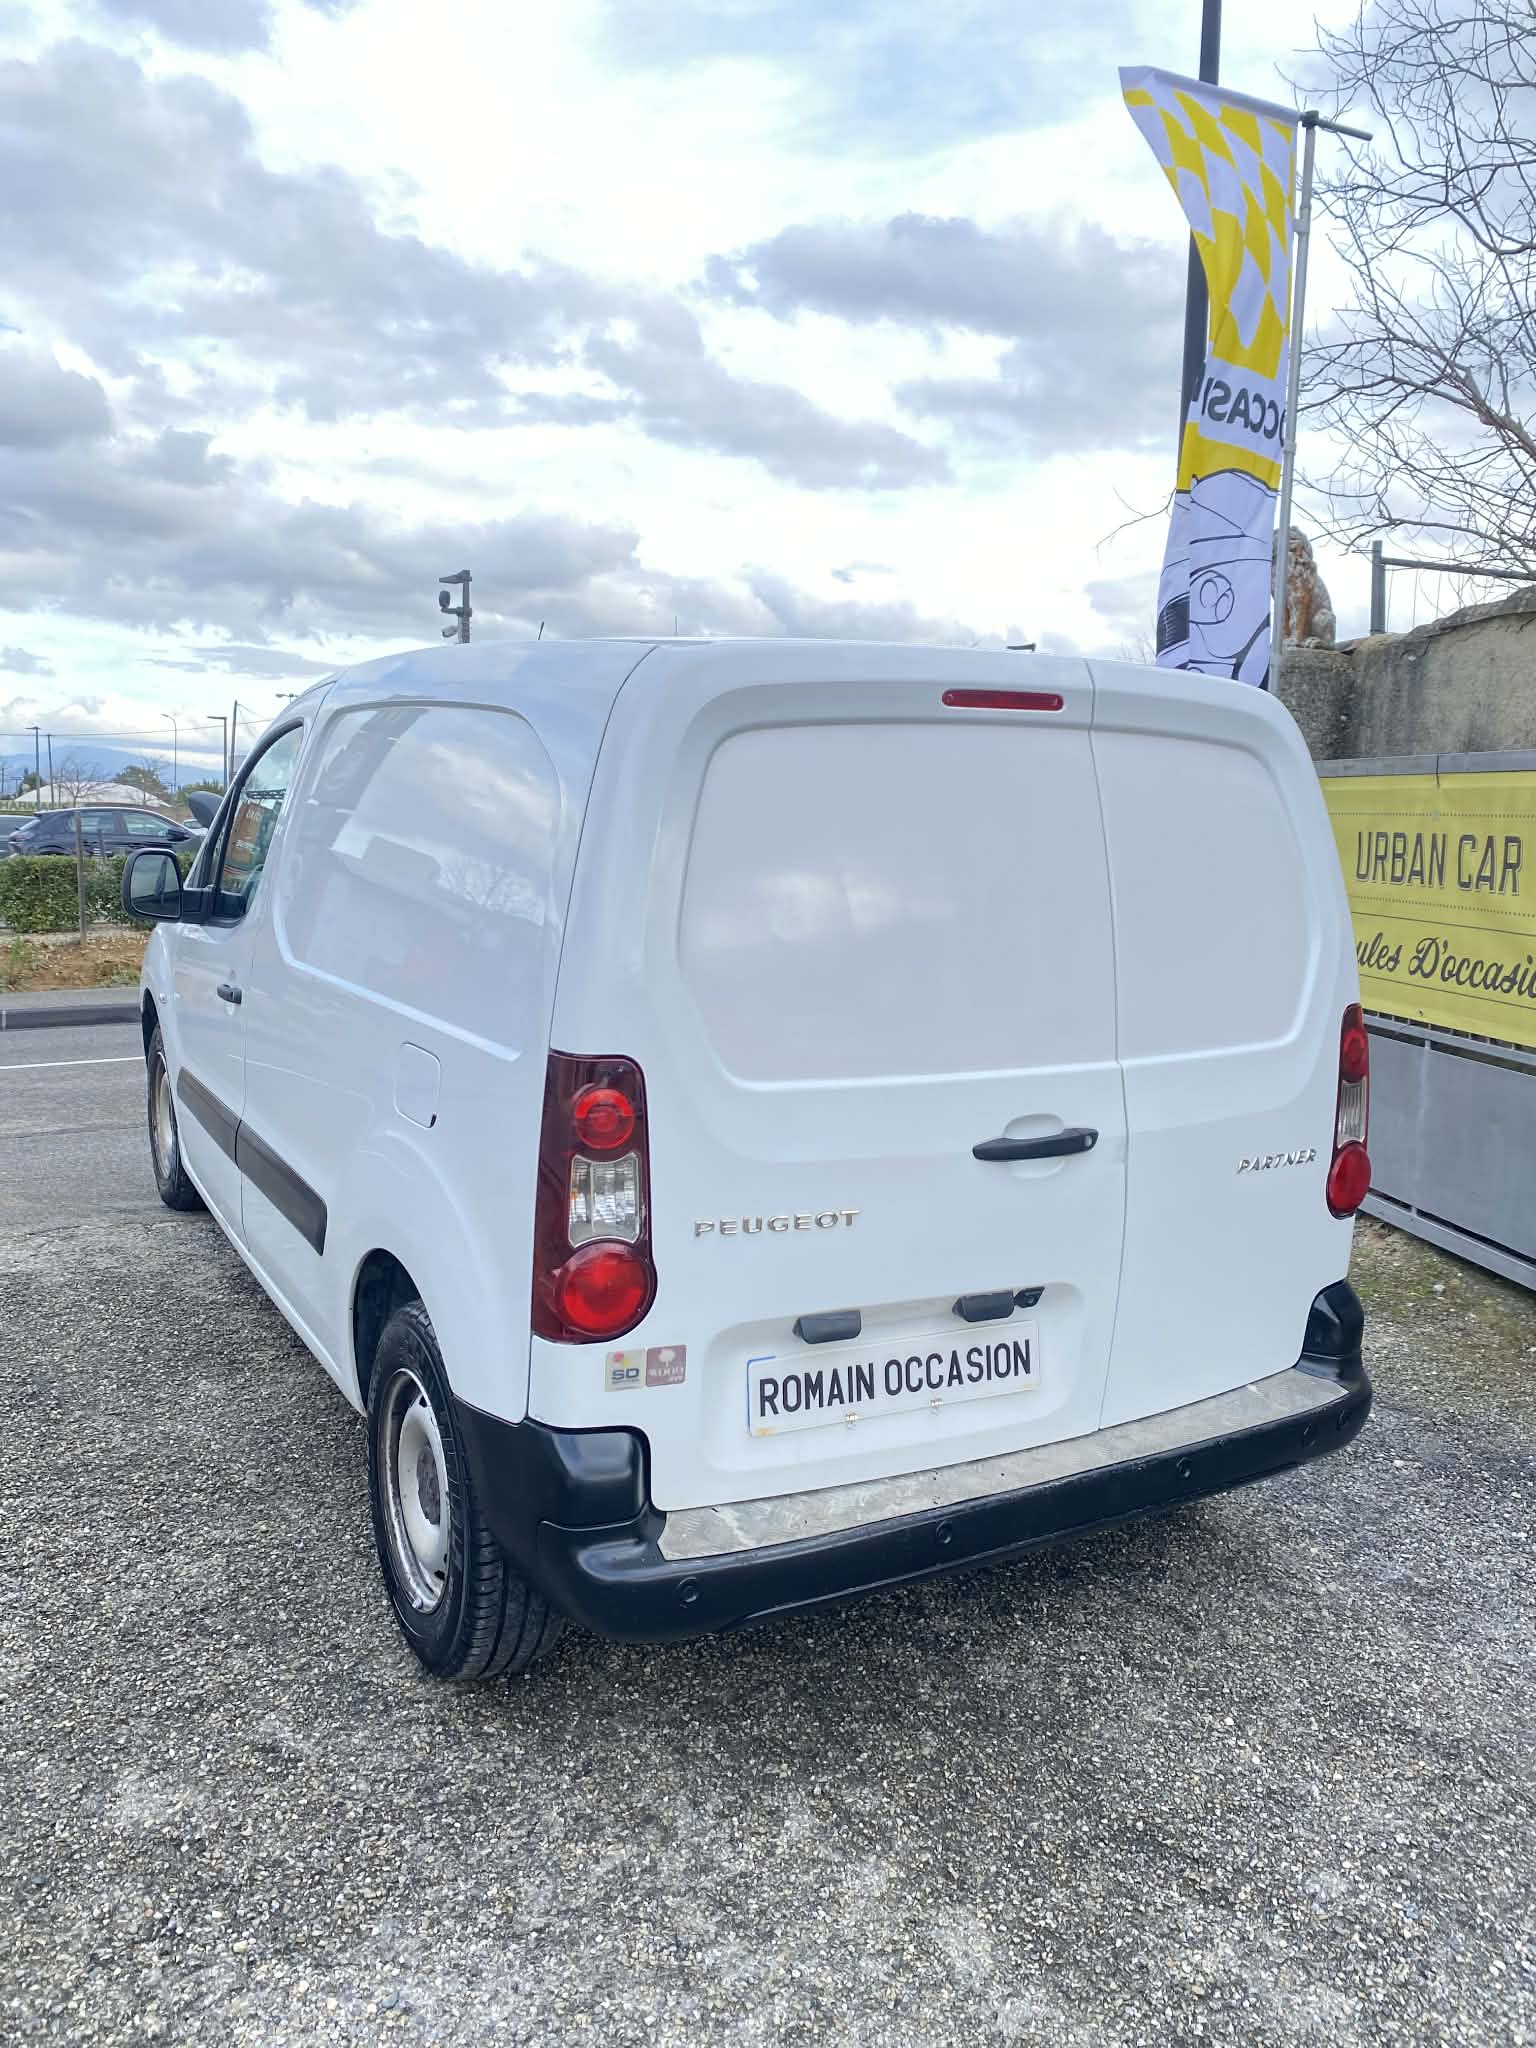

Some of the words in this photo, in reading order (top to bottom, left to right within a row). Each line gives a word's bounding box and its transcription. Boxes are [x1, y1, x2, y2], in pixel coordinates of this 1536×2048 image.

[1355, 831, 1447, 888] URBAN
[1456, 833, 1522, 896] CAR
[1236, 1148, 1317, 1174] PARTNER
[695, 1208, 861, 1238] PEUGEOT
[759, 1361, 875, 1417] ROMAIN
[884, 1338, 1032, 1396] OCCASION
